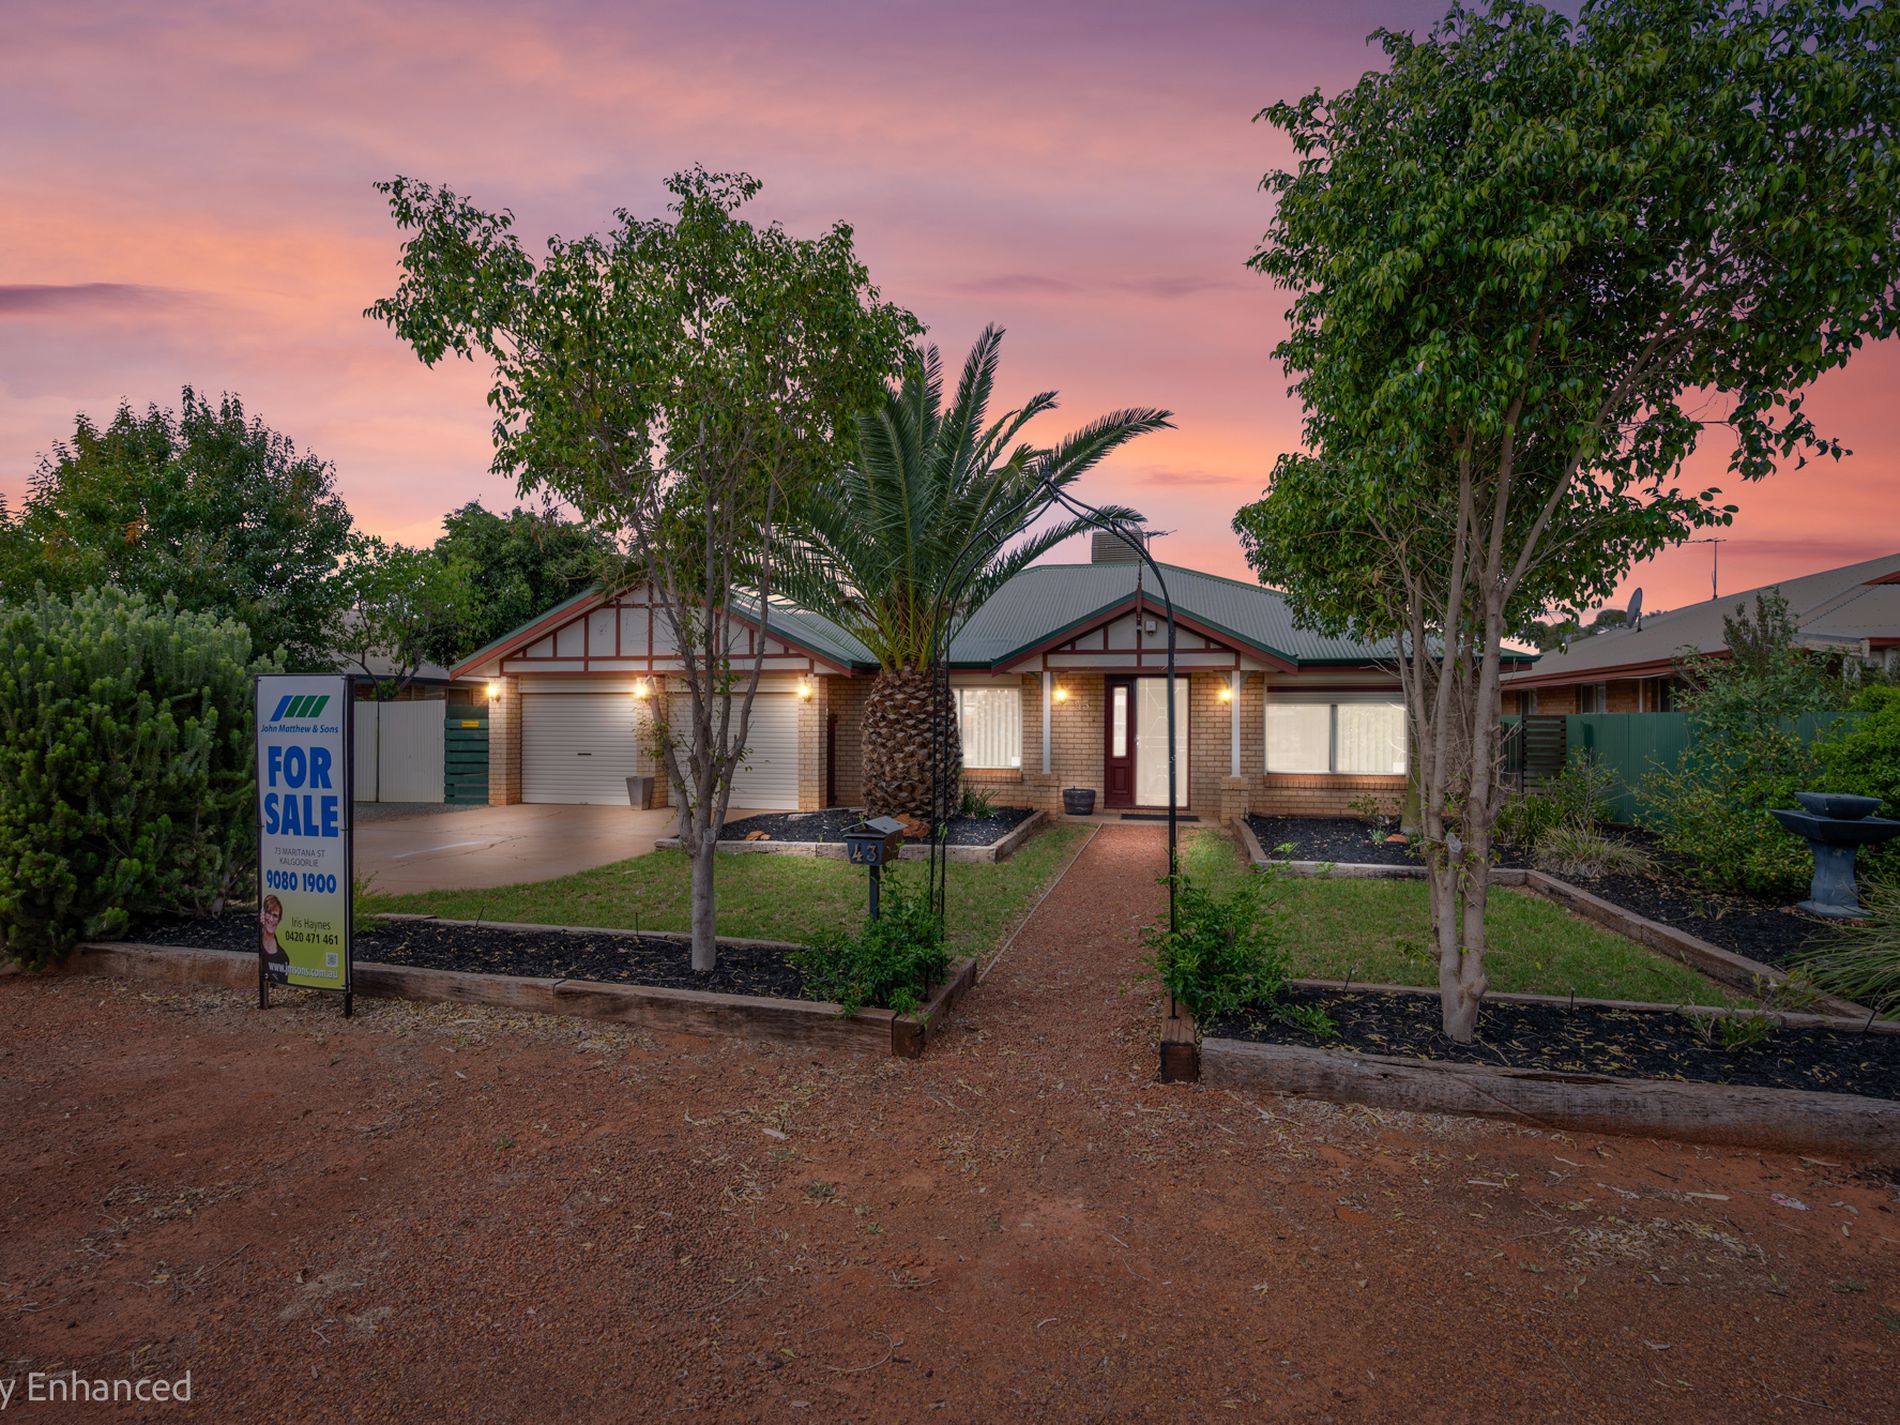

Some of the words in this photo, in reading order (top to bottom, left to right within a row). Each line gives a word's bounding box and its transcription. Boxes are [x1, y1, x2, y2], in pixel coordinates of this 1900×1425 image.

[261, 725, 277, 733] John
[278, 725, 311, 733] Matthew
[312, 725, 318, 733] &
[320, 725, 338, 733] Sons
[268, 746, 331, 789] FOR
[264, 793, 338, 837] SALE
[275, 847, 280, 855] 73
[282, 848, 315, 857] MARITANA
[852, 844, 877, 862] 43
[280, 857, 319, 867] KALGOORLIE
[267, 869, 298, 891] 9080
[302, 873, 336, 894] 1900
[292, 917, 302, 928] Iris
[304, 919, 331, 932] Haynes
[285, 931, 303, 942] 0420
[306, 933, 320, 944] 471
[323, 935, 338, 945] 461
